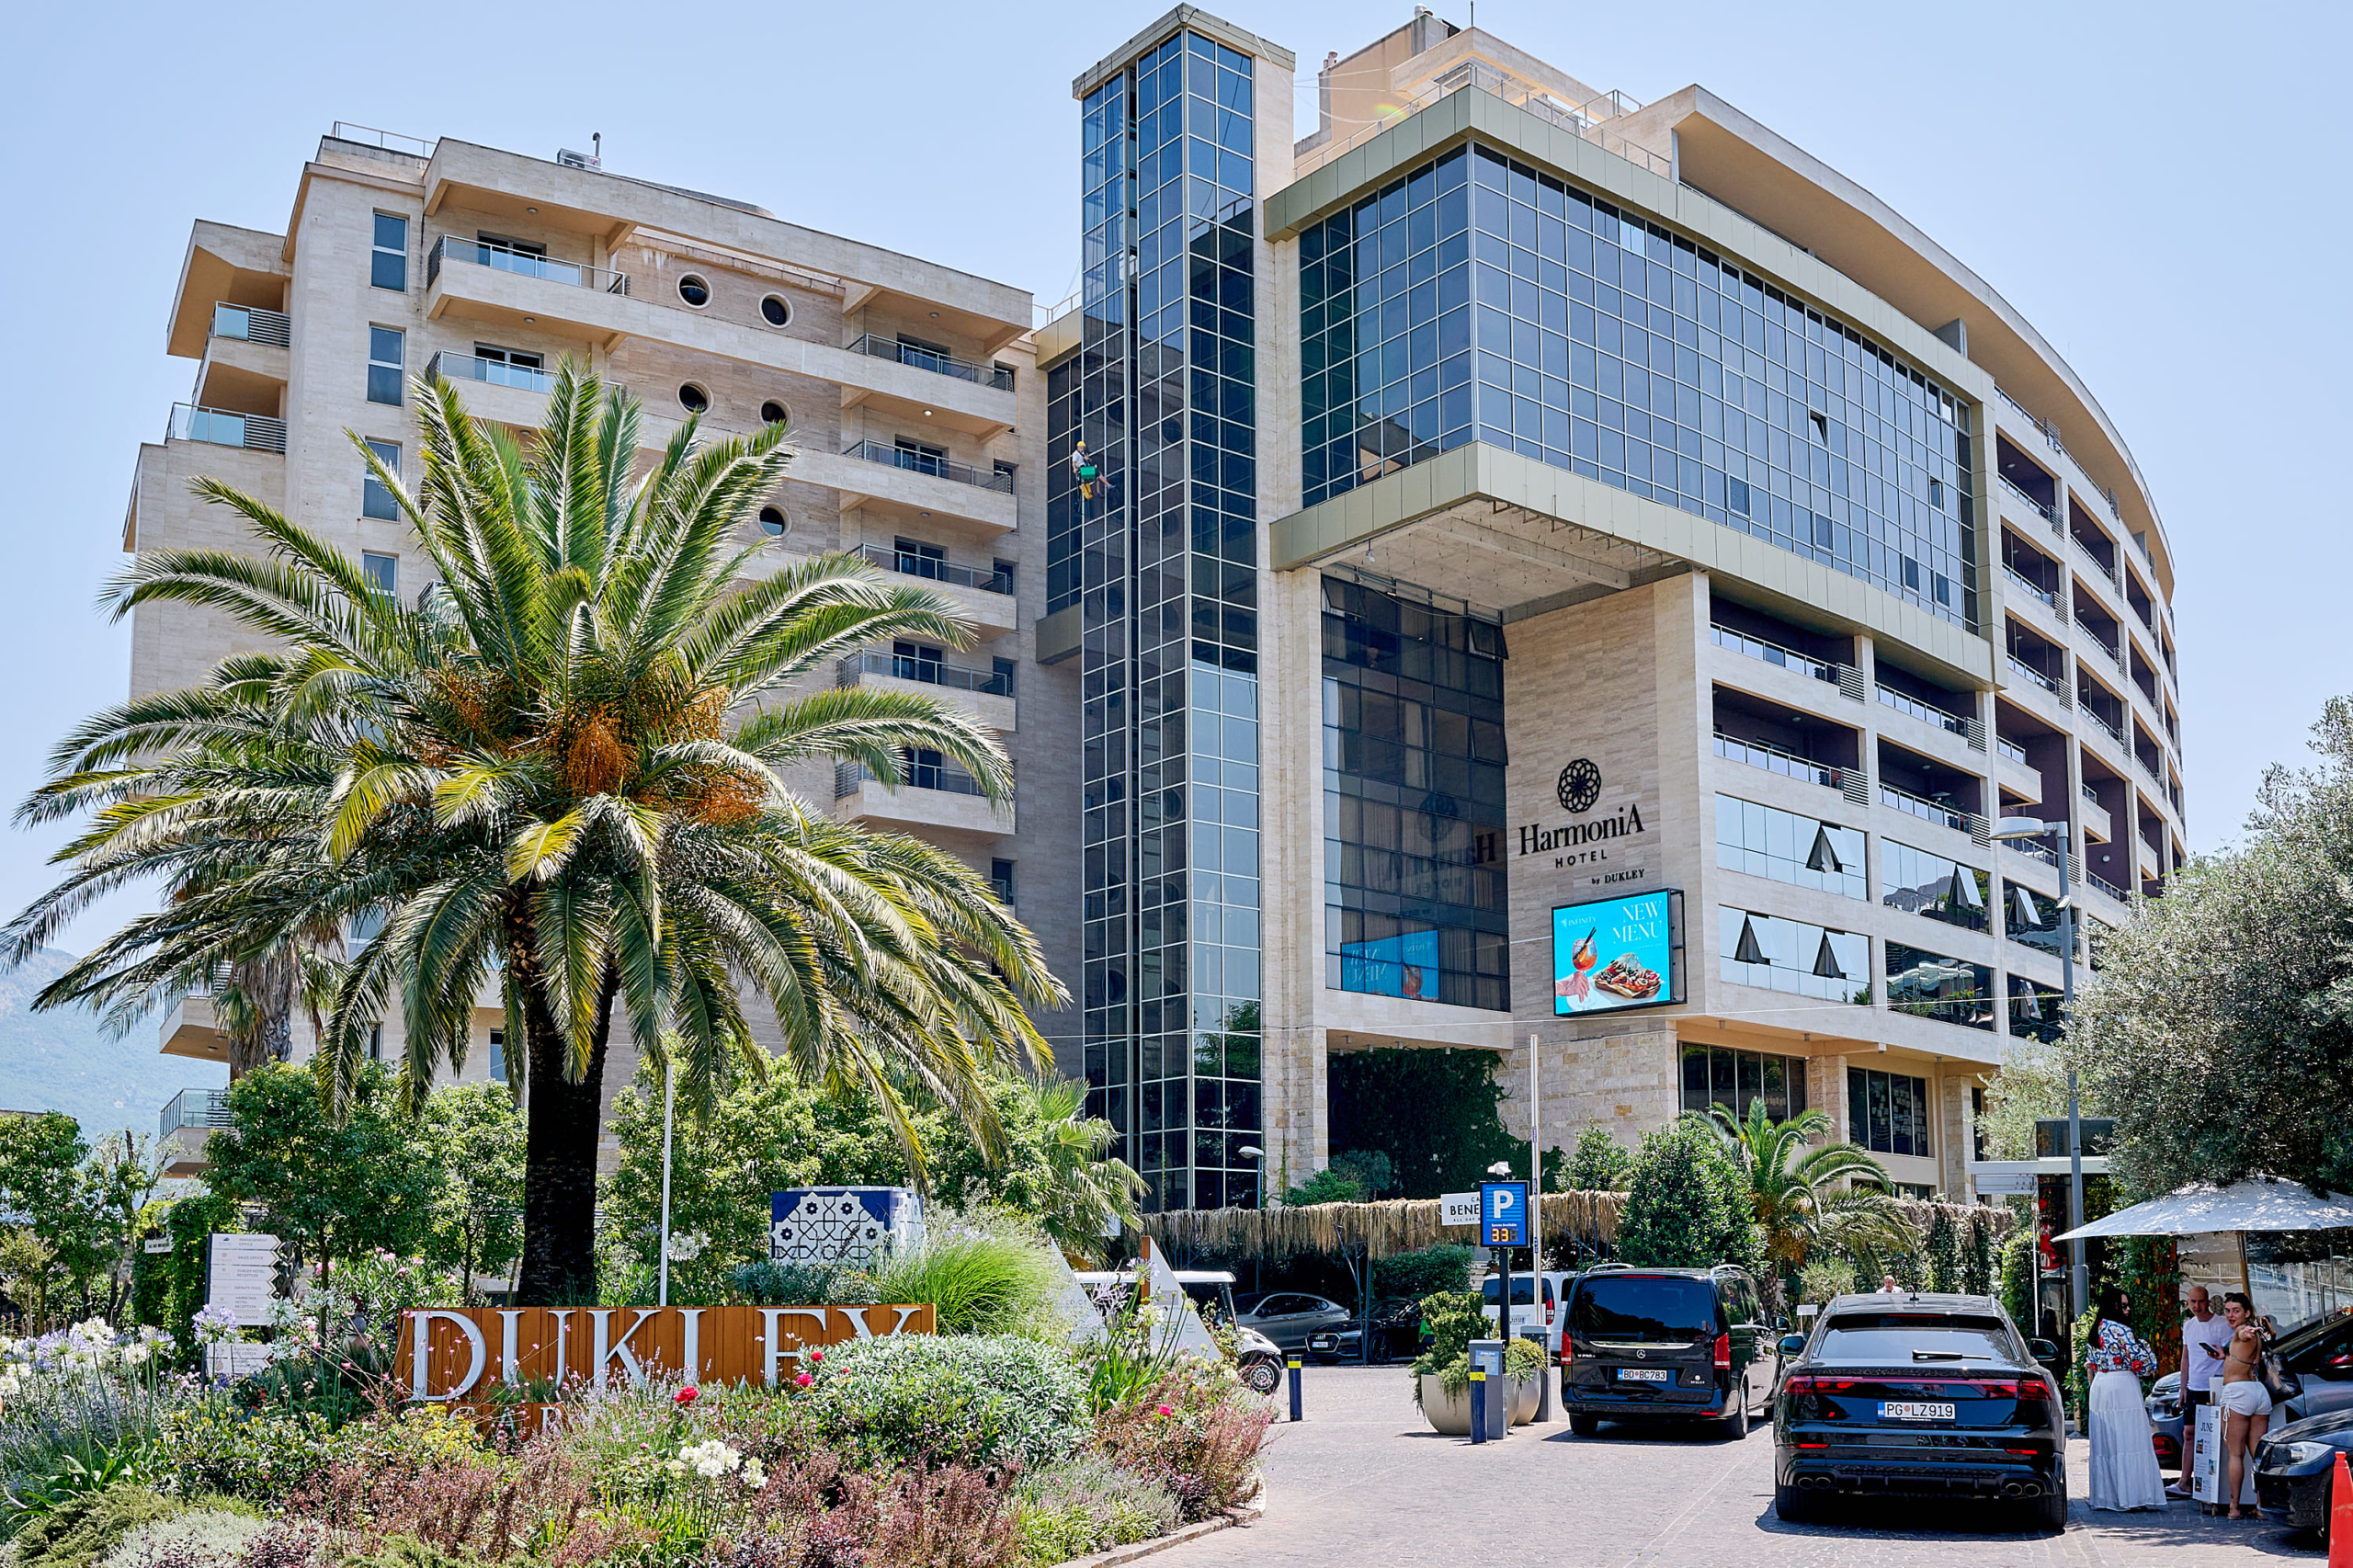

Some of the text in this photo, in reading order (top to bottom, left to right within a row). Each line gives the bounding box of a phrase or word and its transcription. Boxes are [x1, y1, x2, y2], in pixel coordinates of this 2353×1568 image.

[1518, 803, 1645, 856] HarmoniA
[1555, 849, 1608, 868] HOTEL
[1604, 869, 1645, 883] DUKLEY
[1622, 901, 1662, 923] NEW
[1568, 916, 1597, 926] INFINITY
[1613, 920, 1662, 944] MENU
[1493, 1189, 1514, 1219] P
[1492, 1228, 1509, 1243] 33
[1639, 1370, 1665, 1380] BC783
[1886, 1403, 1954, 1417] PG LZ919
[2200, 1422, 2214, 1433] JUNE
